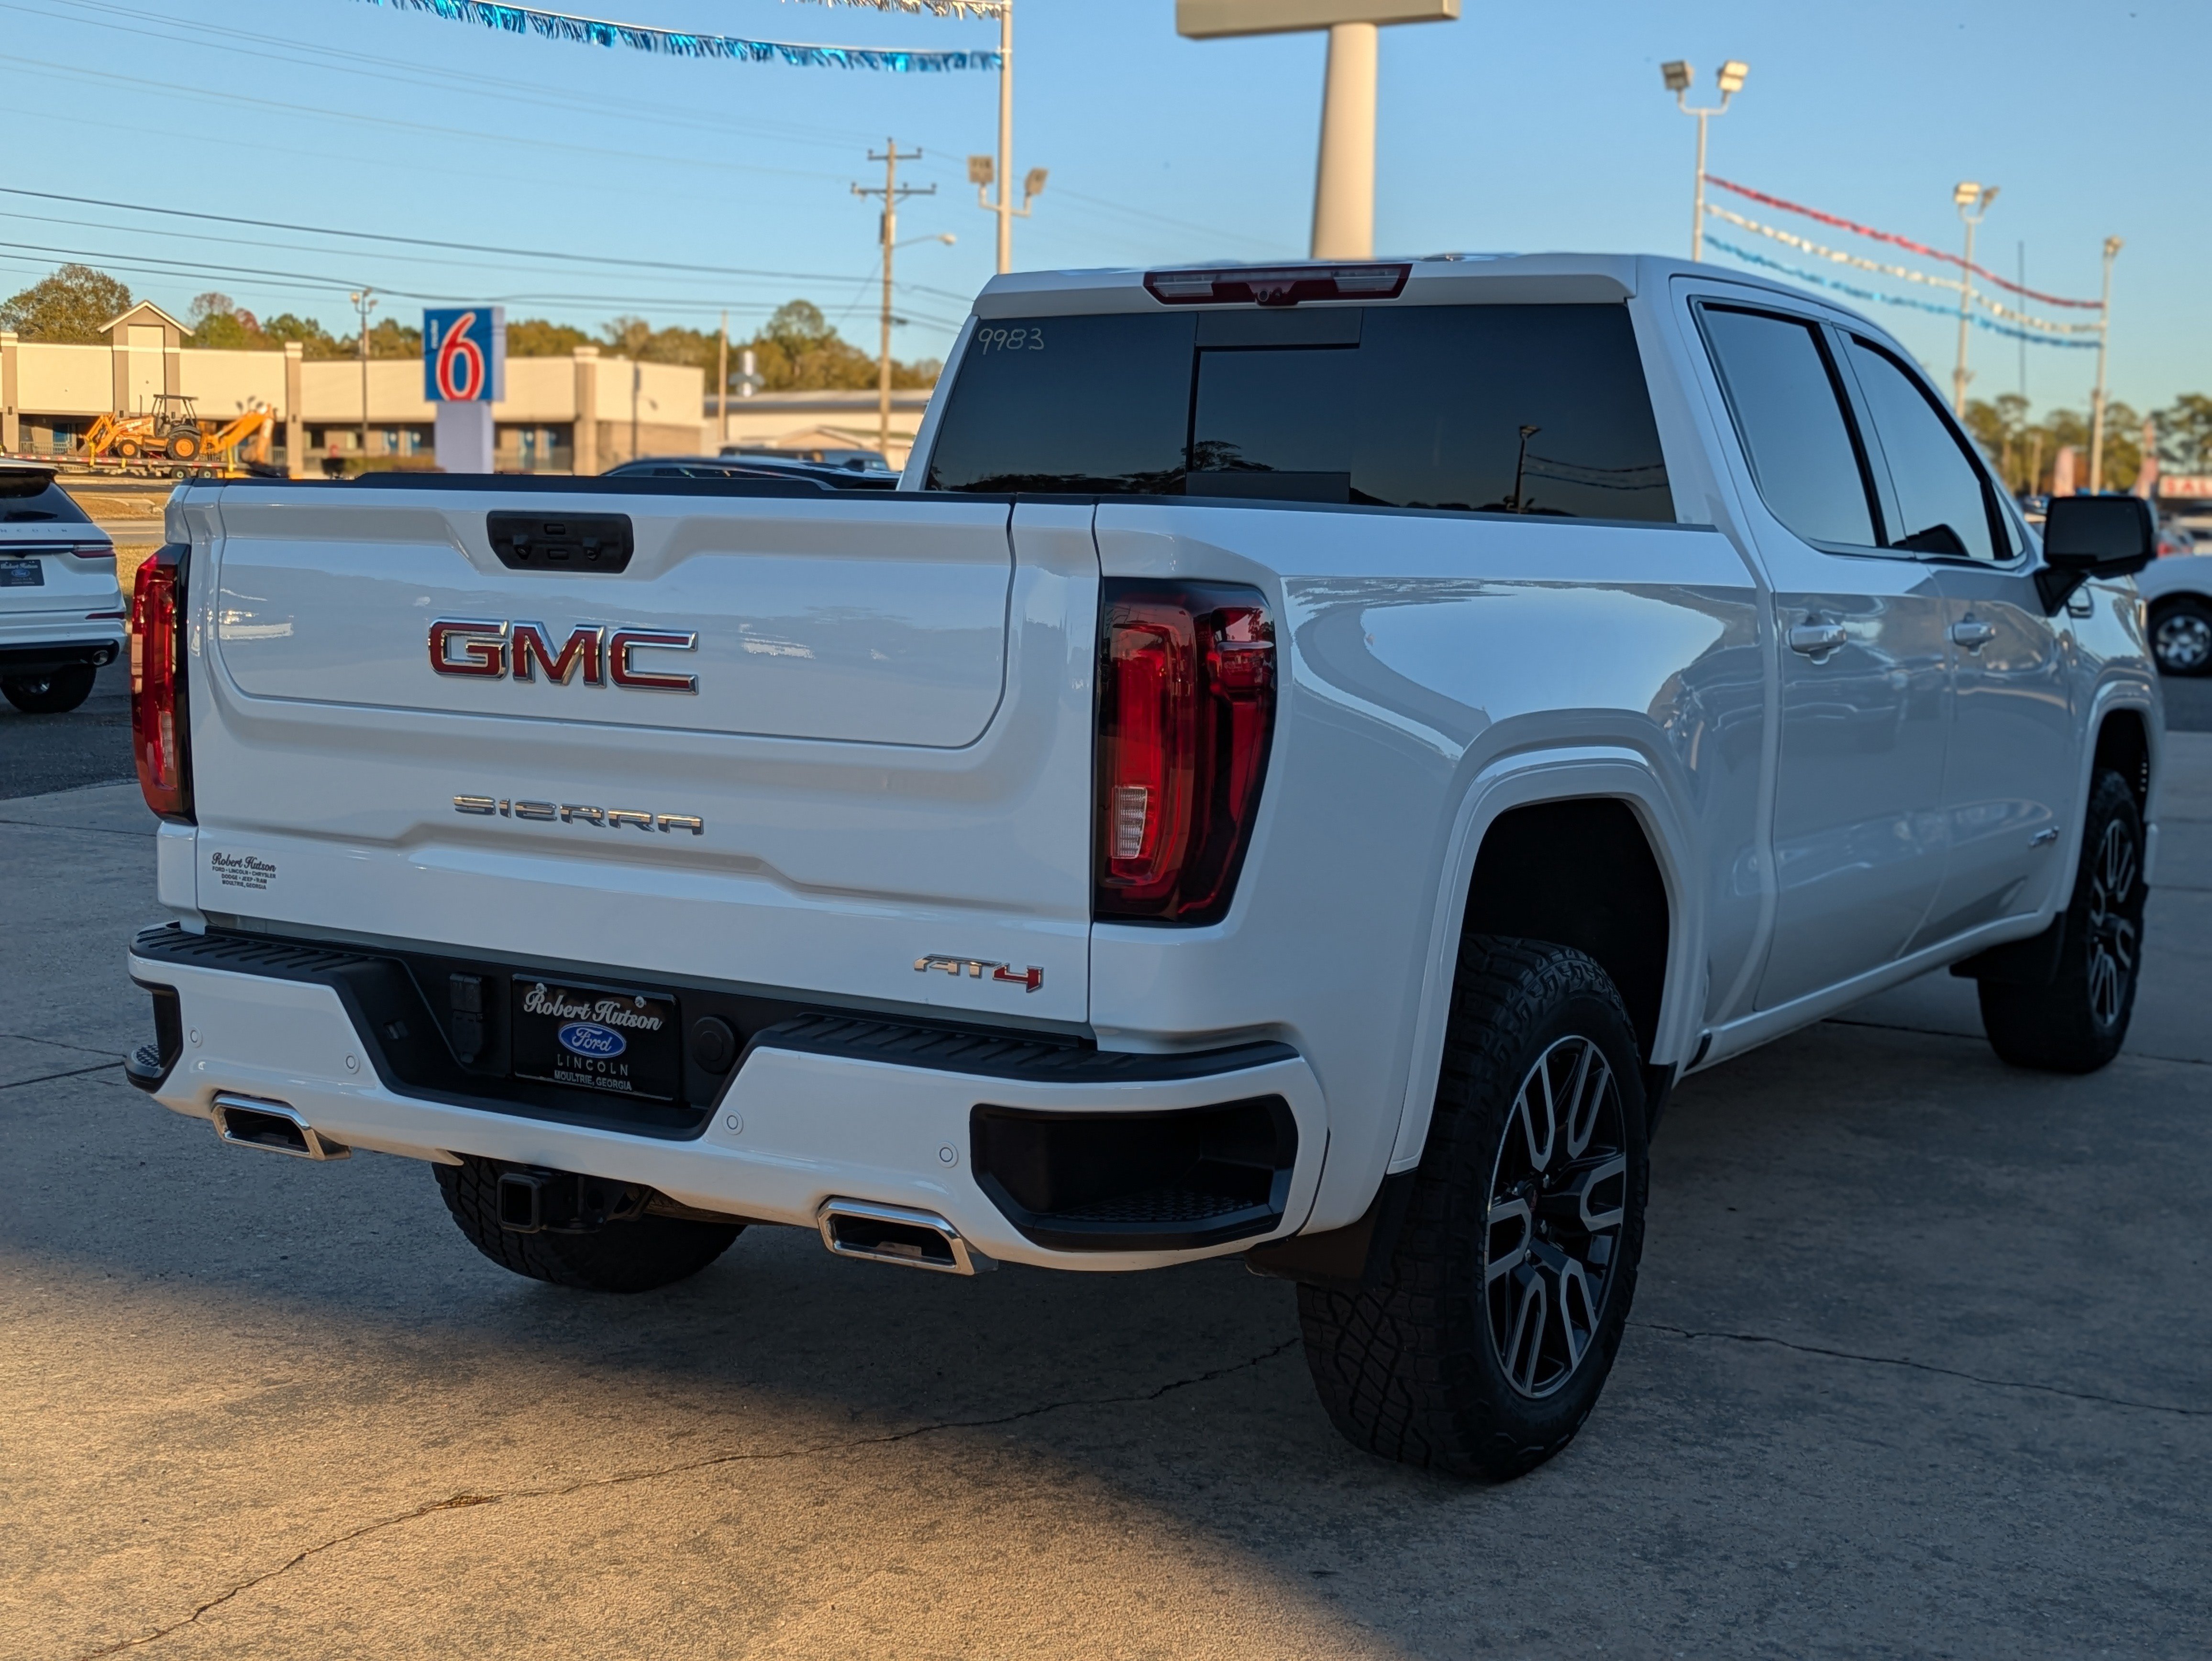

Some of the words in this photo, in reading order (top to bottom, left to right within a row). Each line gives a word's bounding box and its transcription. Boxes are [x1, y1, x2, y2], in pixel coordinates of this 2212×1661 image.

[436, 311, 485, 401] 6
[978, 327, 1045, 355] 9983
[428, 617, 699, 695] GMC
[453, 794, 704, 836] SIERRA
[211, 852, 243, 868] Robert
[244, 856, 276, 872] Hutson
[914, 953, 1044, 993] AT4
[524, 989, 591, 1020] Robert
[592, 1000, 663, 1030] Hutson
[572, 1027, 612, 1052] Ford
[554, 1070, 595, 1086] MOULTRIE,
[596, 1077, 632, 1091] GEORGIA
[557, 1053, 629, 1076] LINCOLN
